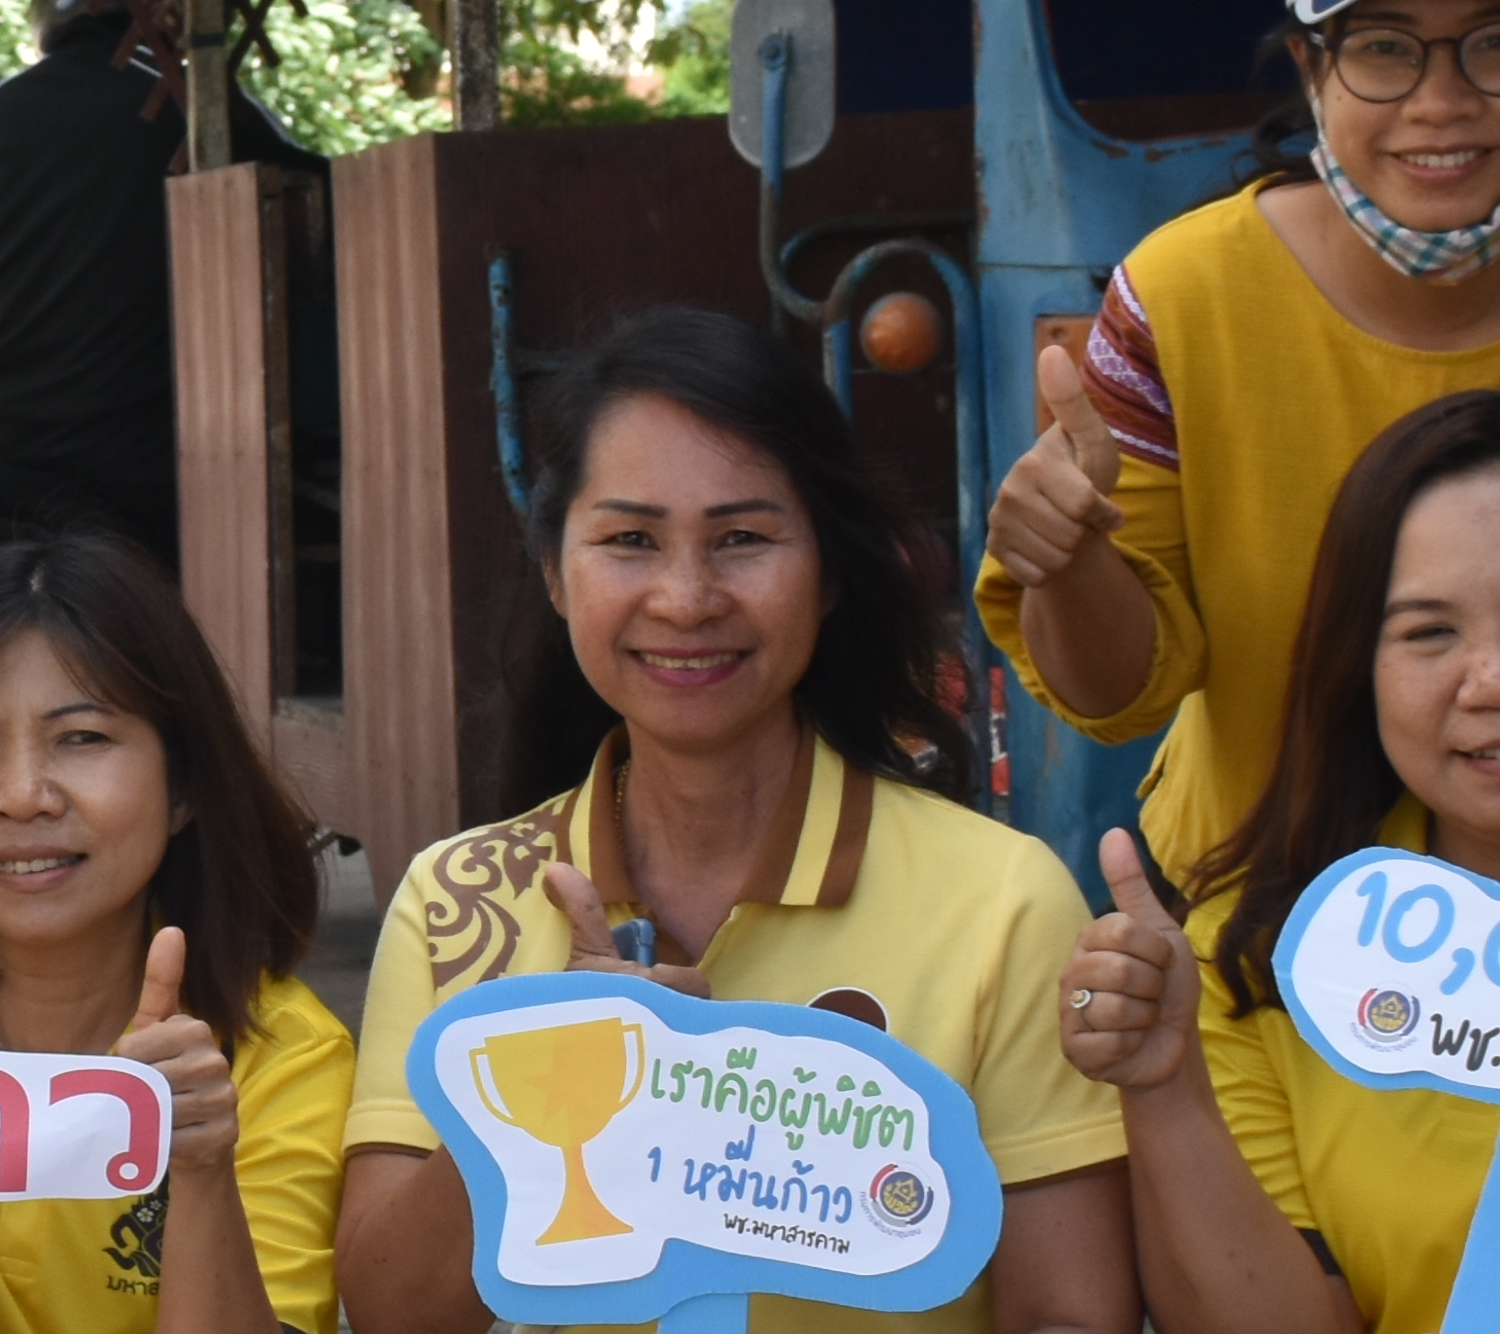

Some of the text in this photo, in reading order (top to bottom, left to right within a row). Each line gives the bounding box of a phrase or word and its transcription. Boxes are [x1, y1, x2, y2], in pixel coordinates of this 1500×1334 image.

[651, 1047, 916, 1152] เราคือผู้พิชิต
[647, 1124, 853, 1225] 1 หมื่นก้าว
[723, 1212, 851, 1255] พช.มหาสารคาม
